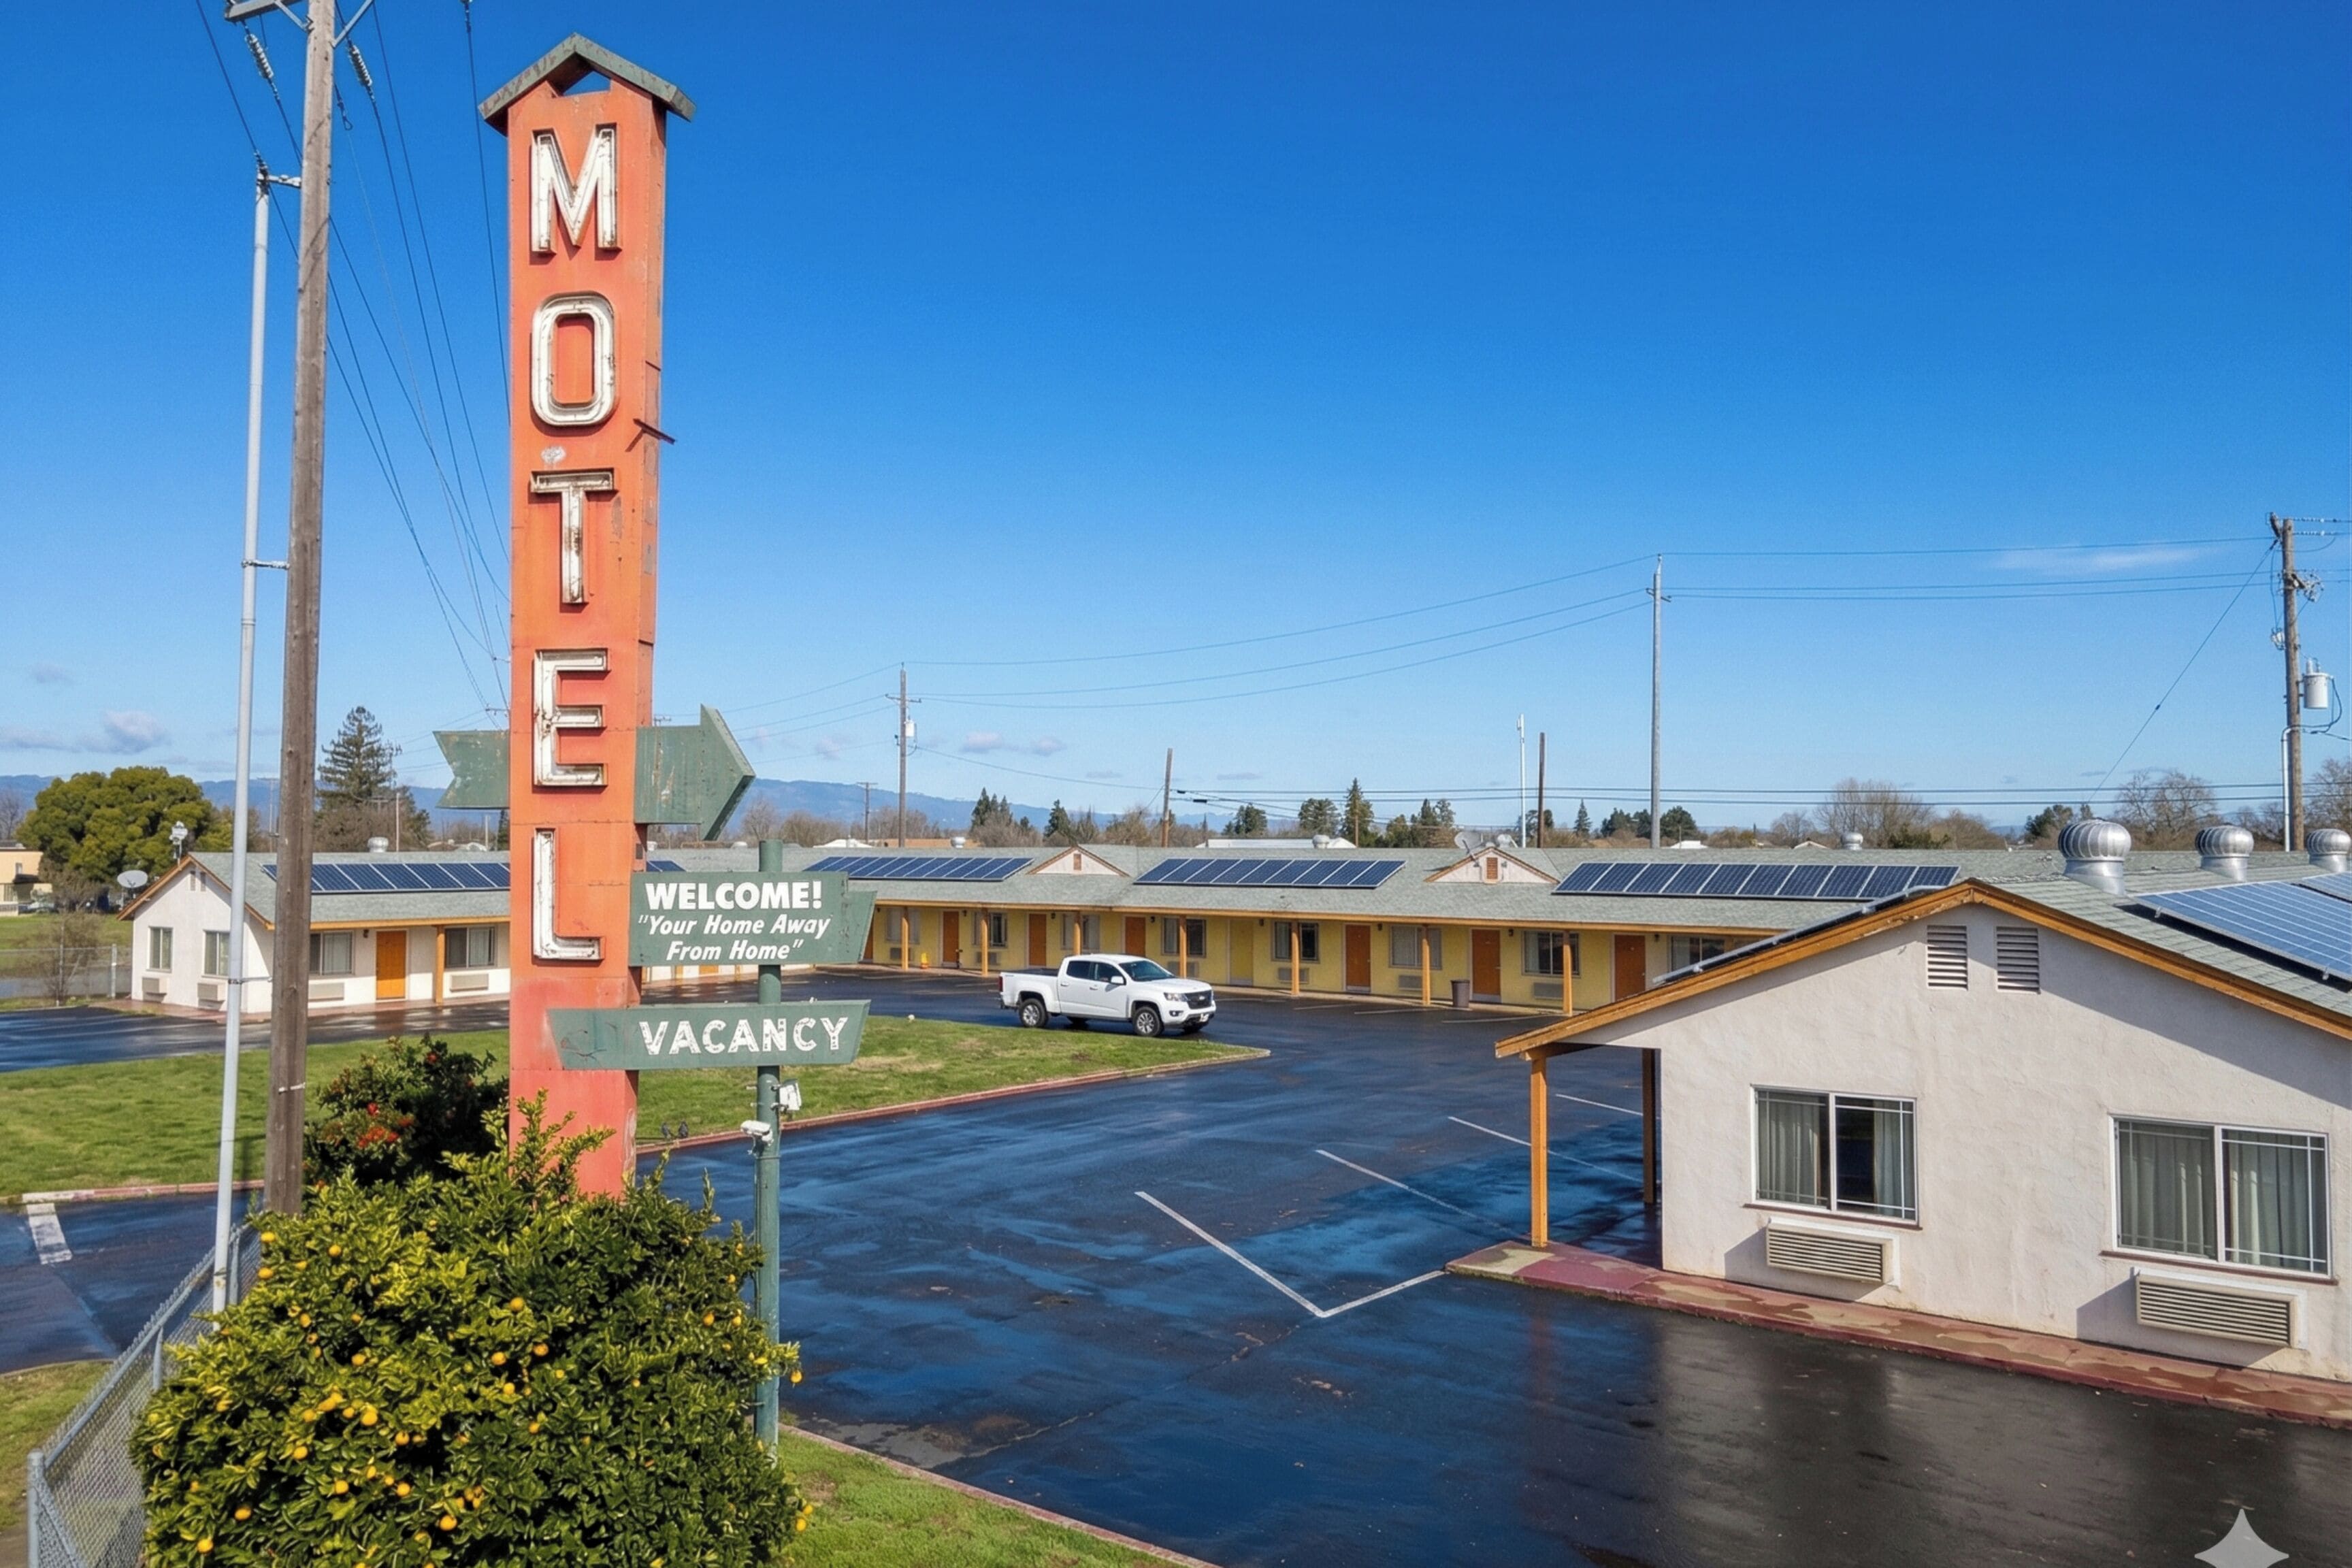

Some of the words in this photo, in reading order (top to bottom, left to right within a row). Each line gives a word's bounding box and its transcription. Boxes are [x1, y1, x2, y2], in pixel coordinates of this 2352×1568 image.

[531, 122, 618, 961] MOTEL
[645, 881, 822, 910] WELCOME!
[638, 915, 697, 935] "Your
[704, 915, 764, 935] Home
[770, 914, 831, 939] Away
[666, 941, 721, 960] From
[729, 939, 804, 960] Home"
[639, 1017, 849, 1056] VACANCY
